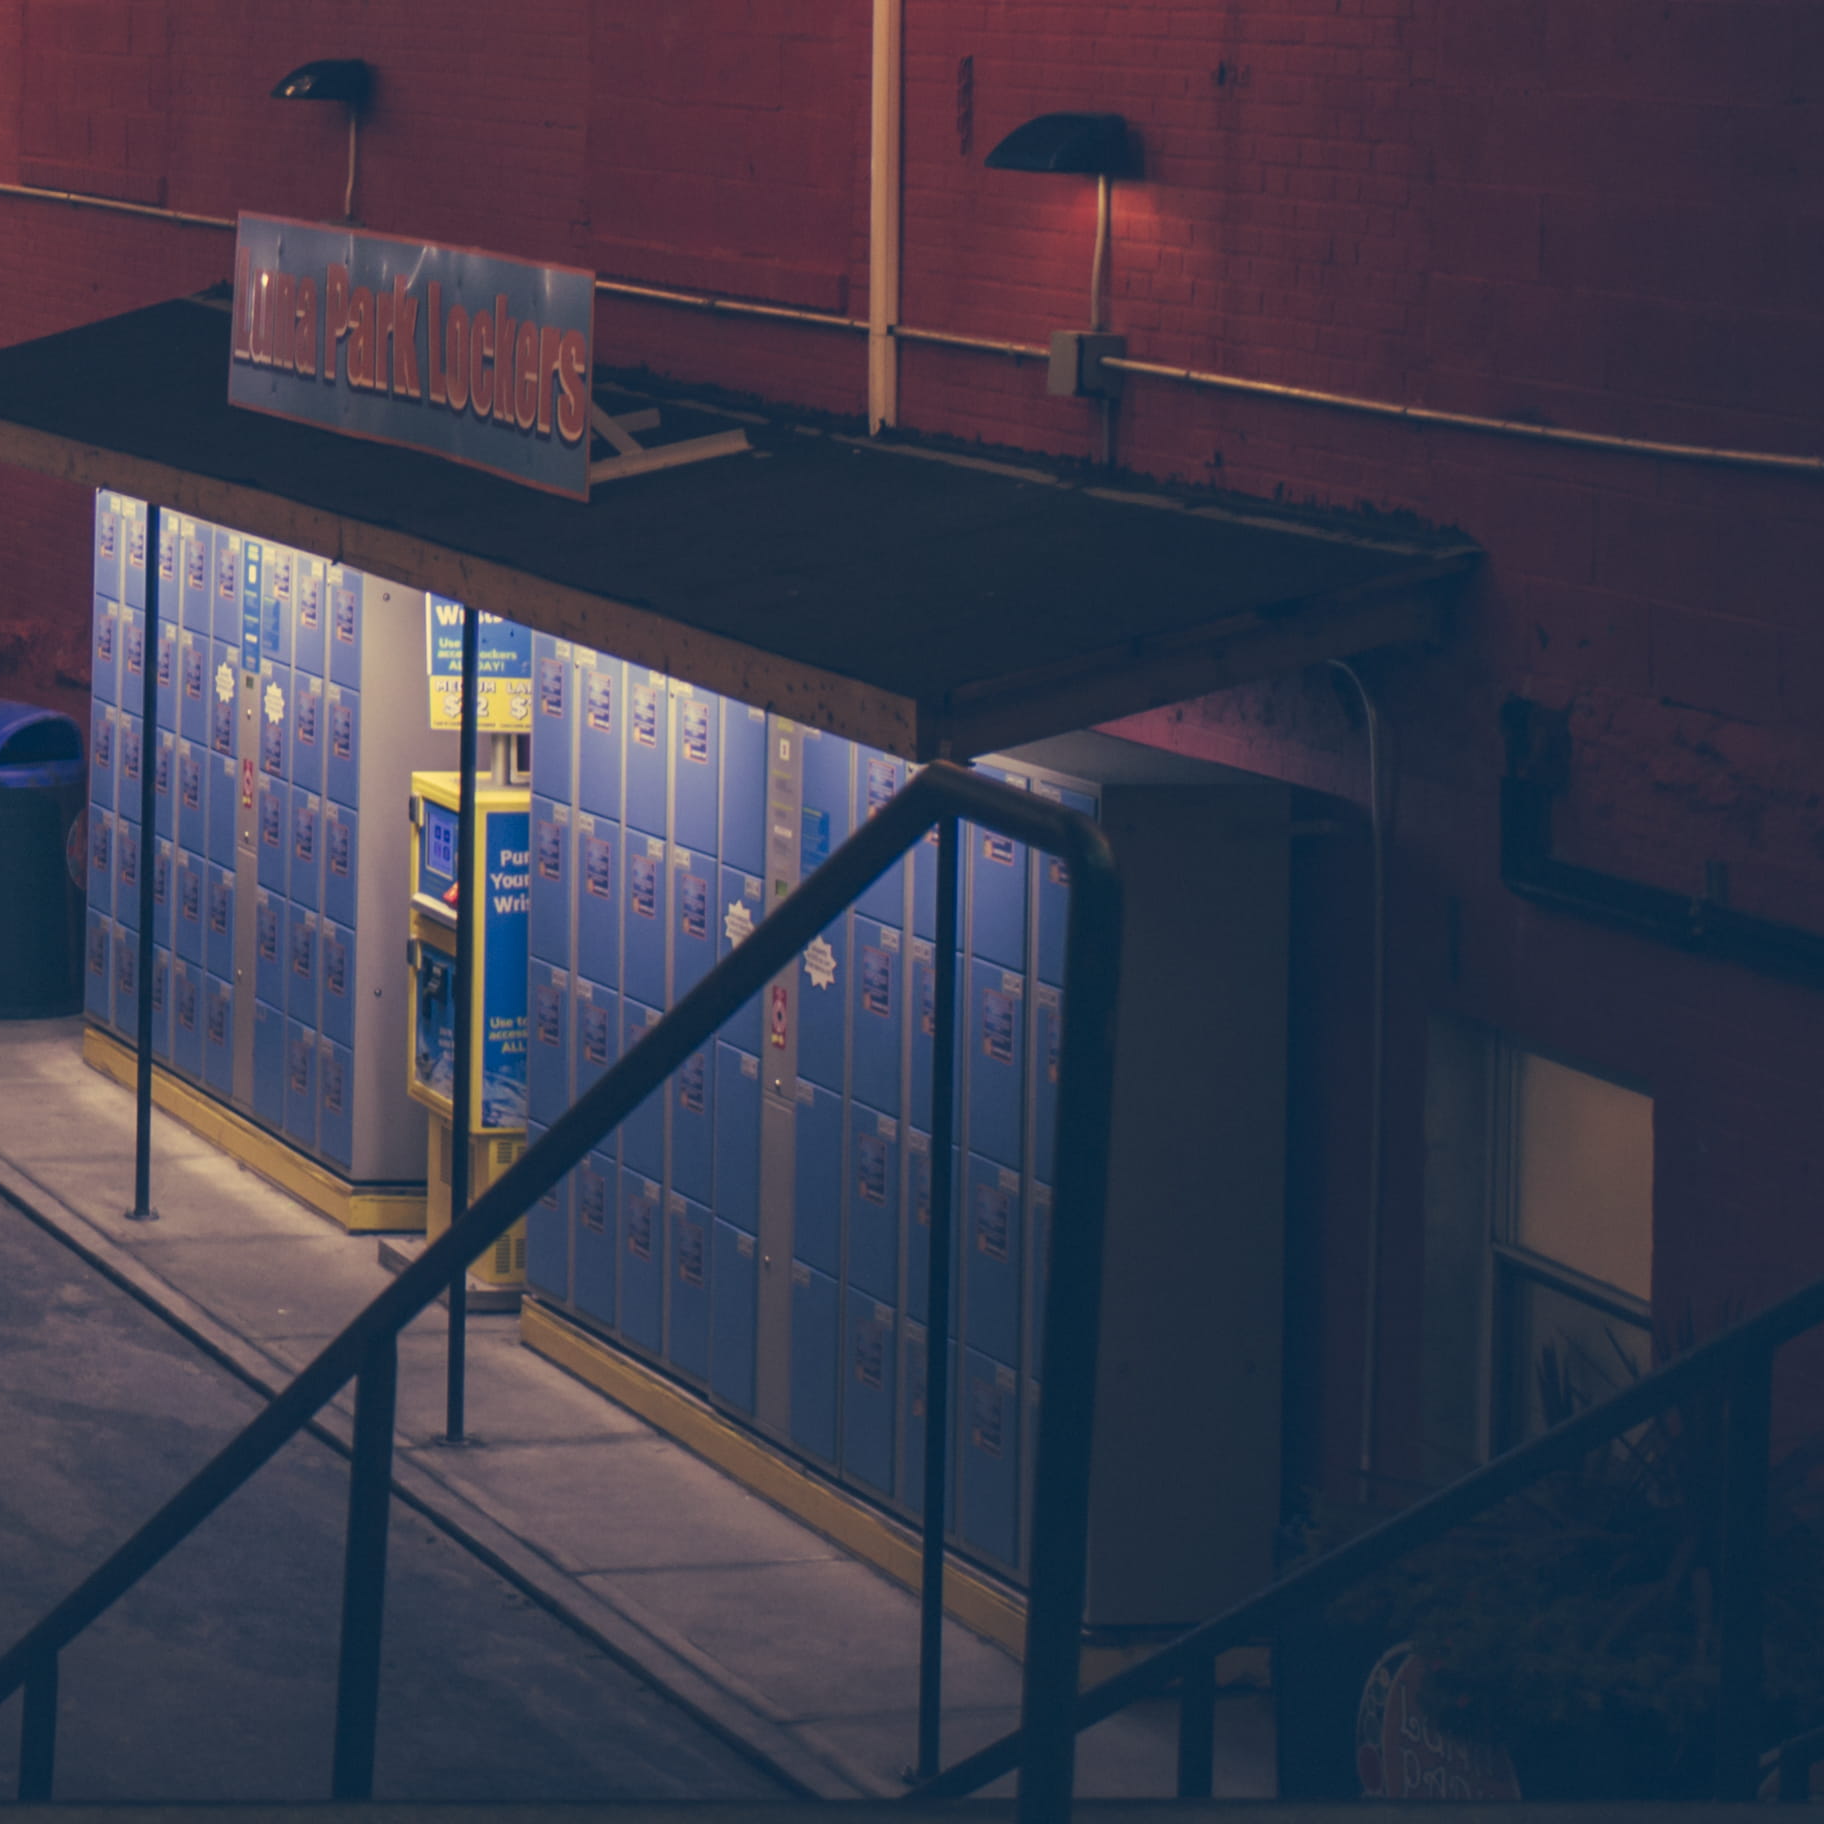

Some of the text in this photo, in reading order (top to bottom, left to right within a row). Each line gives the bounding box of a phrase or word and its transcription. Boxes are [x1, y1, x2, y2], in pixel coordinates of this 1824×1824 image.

[233, 246, 586, 447] Luna Park Lockers
